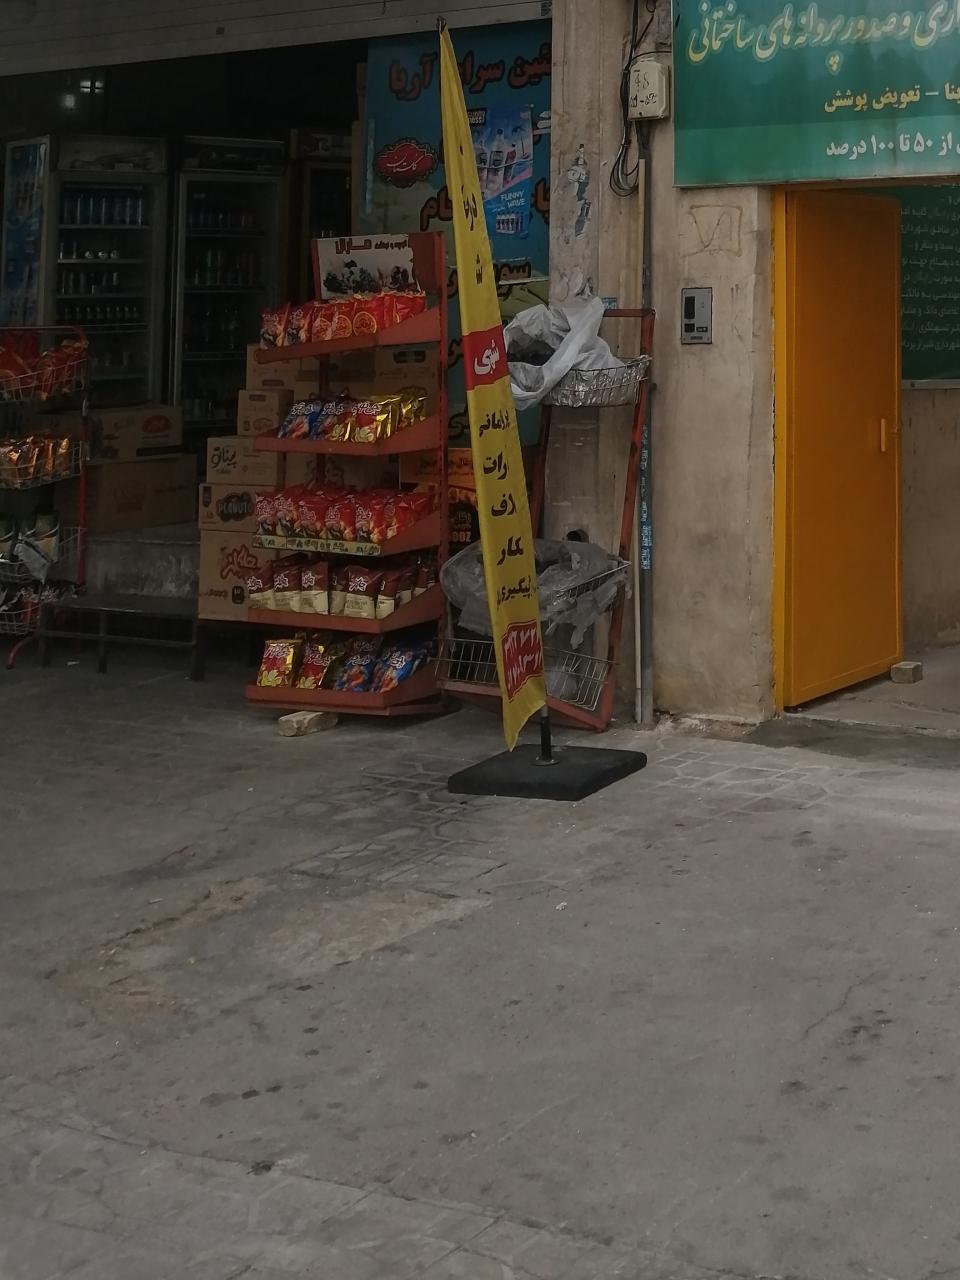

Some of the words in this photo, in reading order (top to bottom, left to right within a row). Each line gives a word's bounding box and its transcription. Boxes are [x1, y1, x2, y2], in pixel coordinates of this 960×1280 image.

[824, 89, 867, 113] پوشش
[872, 85, 921, 111] تعویض
[826, 138, 867, 160] درصد
[899, 132, 911, 154] تا
[938, 131, 953, 157] از
